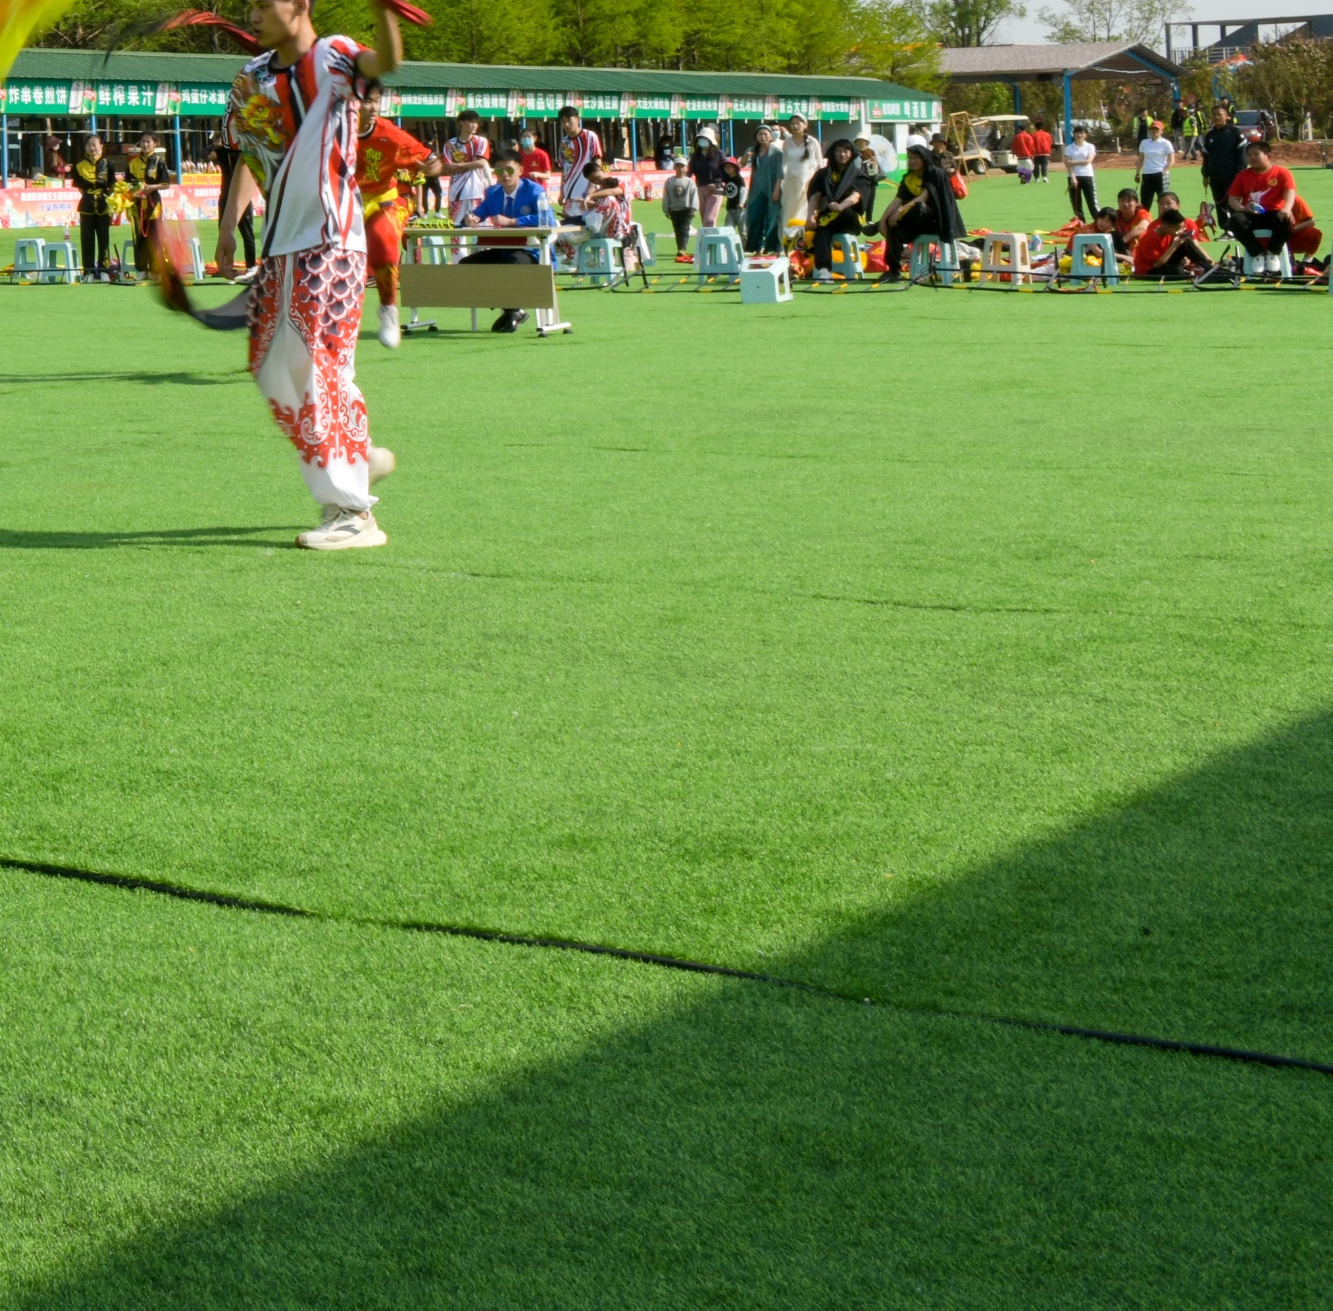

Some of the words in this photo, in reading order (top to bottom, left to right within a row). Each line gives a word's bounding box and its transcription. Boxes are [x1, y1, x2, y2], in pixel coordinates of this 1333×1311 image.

[8, 84, 67, 105] 炸串卷煎饼
[98, 83, 154, 107] 鲜榨果汁
